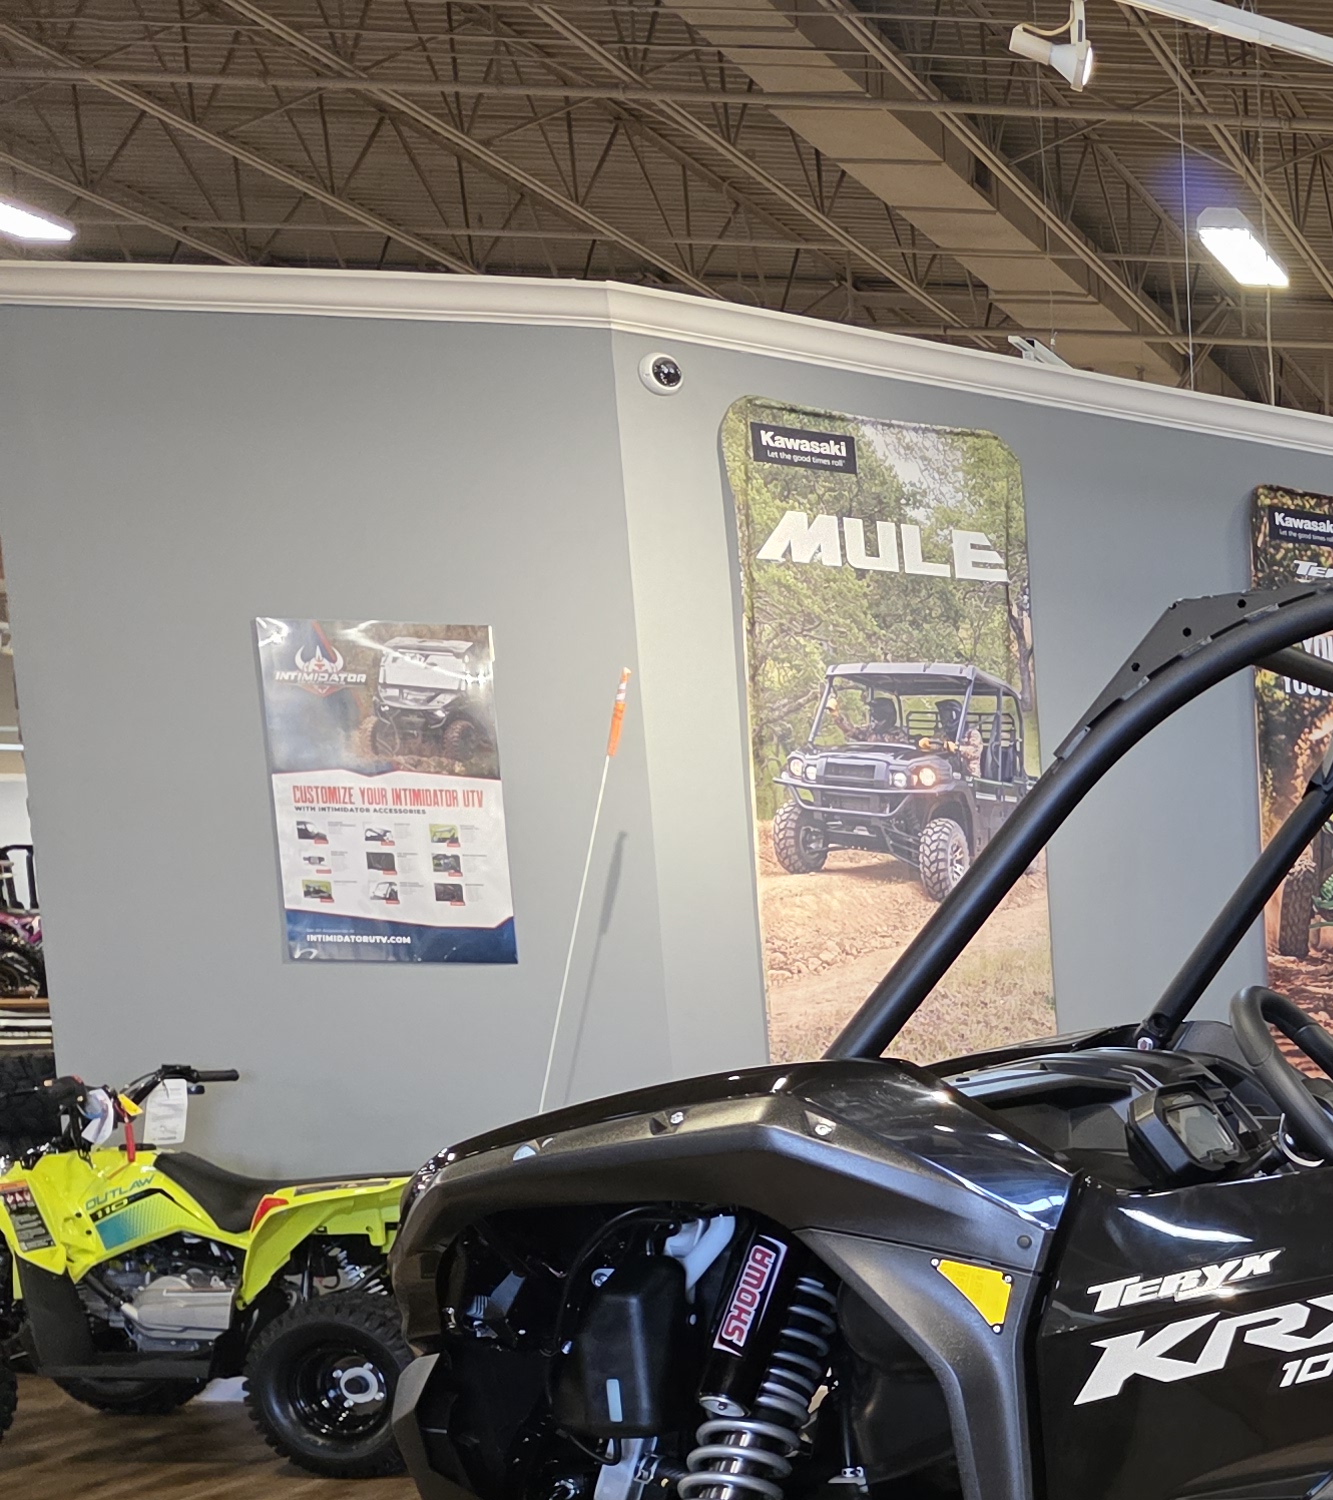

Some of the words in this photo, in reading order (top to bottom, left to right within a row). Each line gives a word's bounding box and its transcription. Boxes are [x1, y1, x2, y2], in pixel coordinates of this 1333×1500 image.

[760, 430, 847, 457] Kawasaki
[767, 450, 779, 459] Let
[779, 451, 791, 460] the
[793, 454, 811, 463] good
[812, 456, 831, 466] times
[756, 510, 1010, 582] MULE
[1298, 532, 1312, 541] good
[1312, 533, 1326, 542] times
[275, 671, 367, 683] INTIMIDATOR
[292, 785, 355, 804] CUSTOMIZE
[359, 787, 388, 806] YOUR
[391, 788, 458, 808] INTIMIDATOR
[463, 789, 483, 808] UTV
[306, 934, 411, 944] INTIMIDATORUTV.COM
[86, 1174, 155, 1211] OUTLAW
[96, 1198, 128, 1219] 110
[1086, 1247, 1286, 1313] TERYX
[721, 1245, 776, 1348] SHOWA
